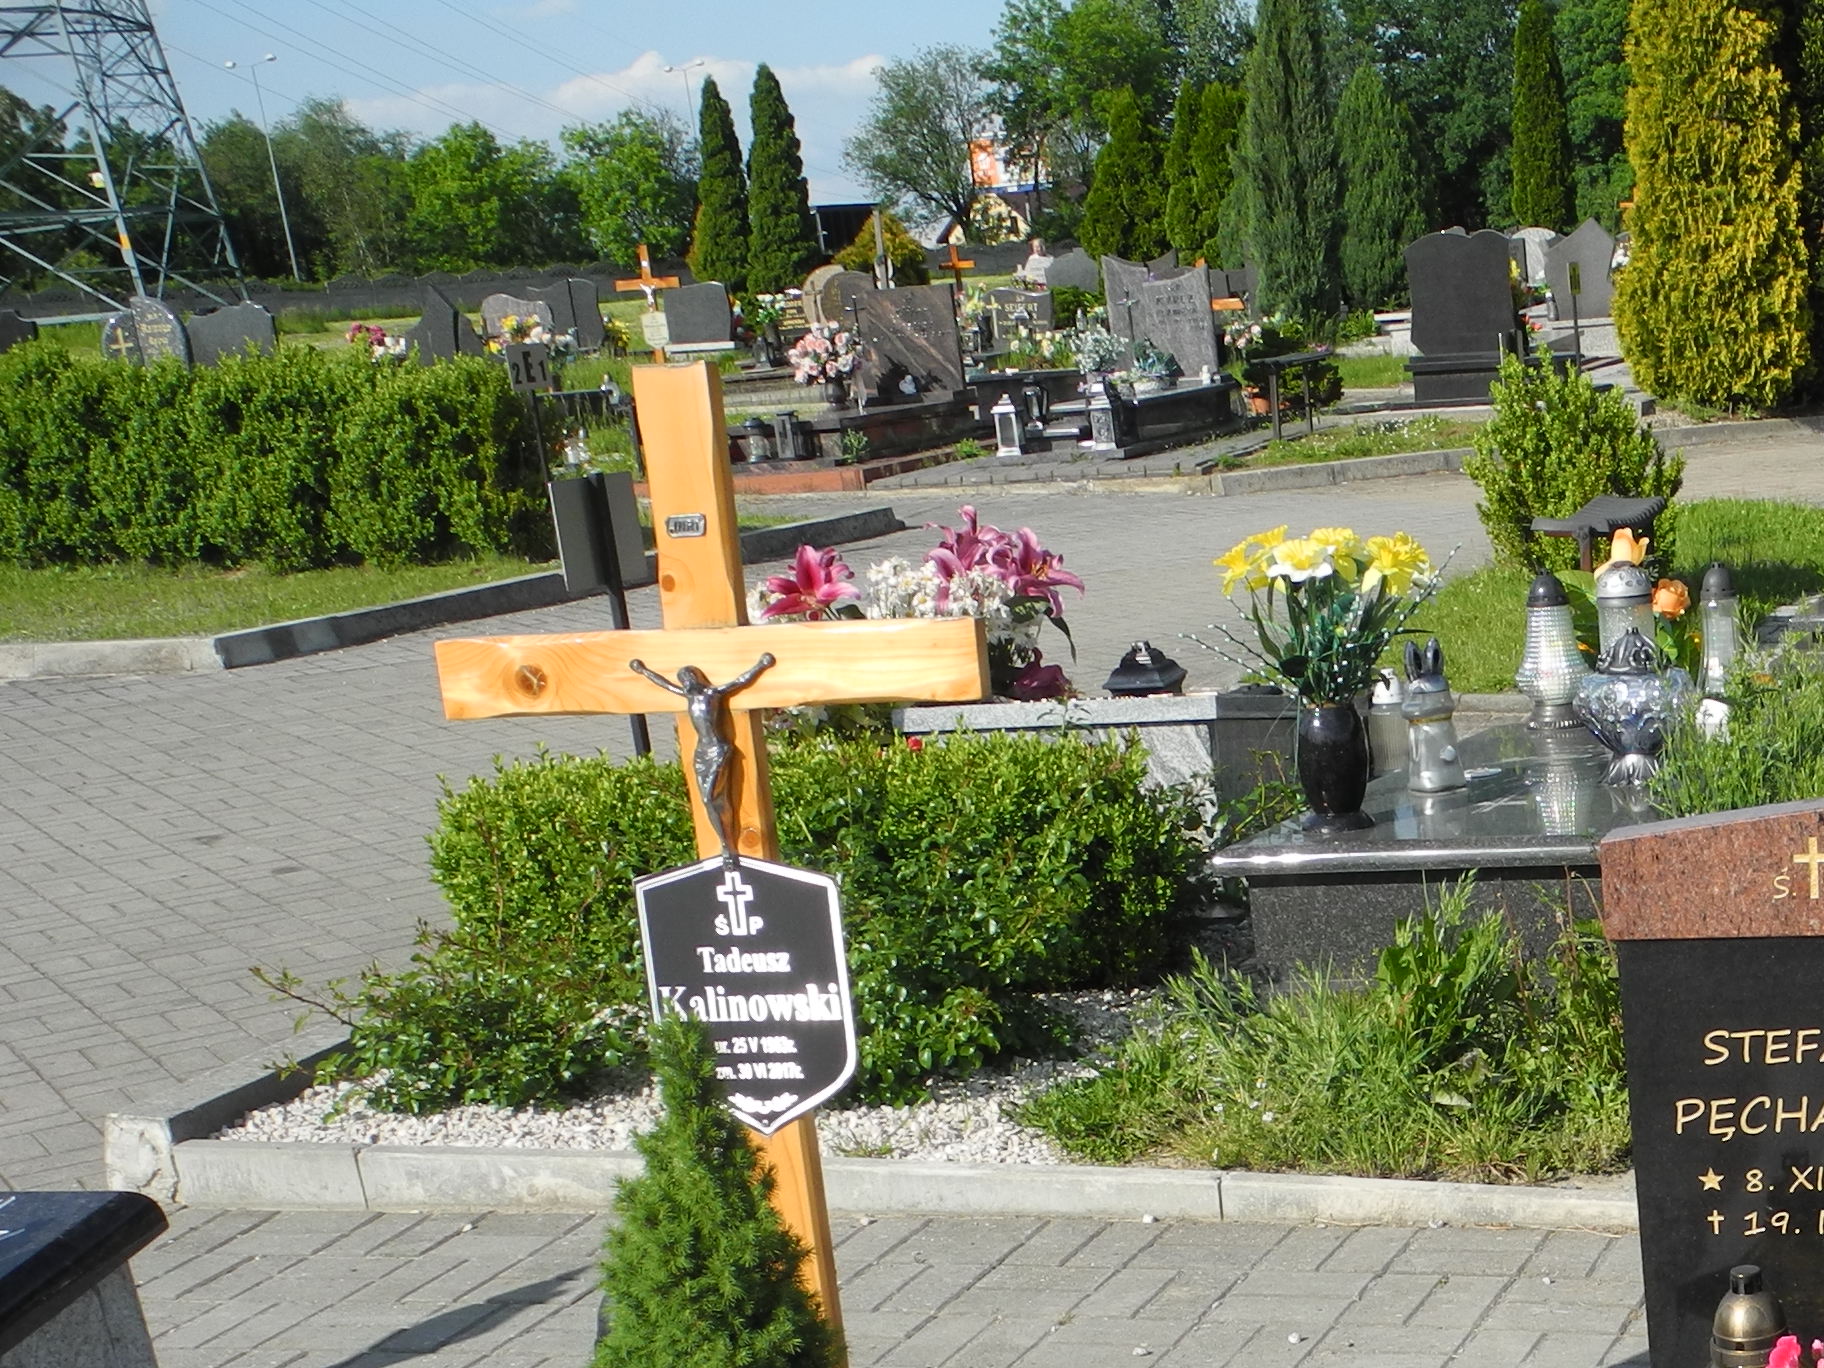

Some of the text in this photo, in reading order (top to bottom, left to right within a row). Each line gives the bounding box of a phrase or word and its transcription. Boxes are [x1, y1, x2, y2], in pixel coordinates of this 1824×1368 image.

[748, 916, 764, 935] P
[697, 947, 791, 973] Tadeusz
[658, 982, 842, 1022] Kalinowski
[1745, 1168, 1775, 1193] 8.
[1745, 1210, 1800, 1236] 19.
